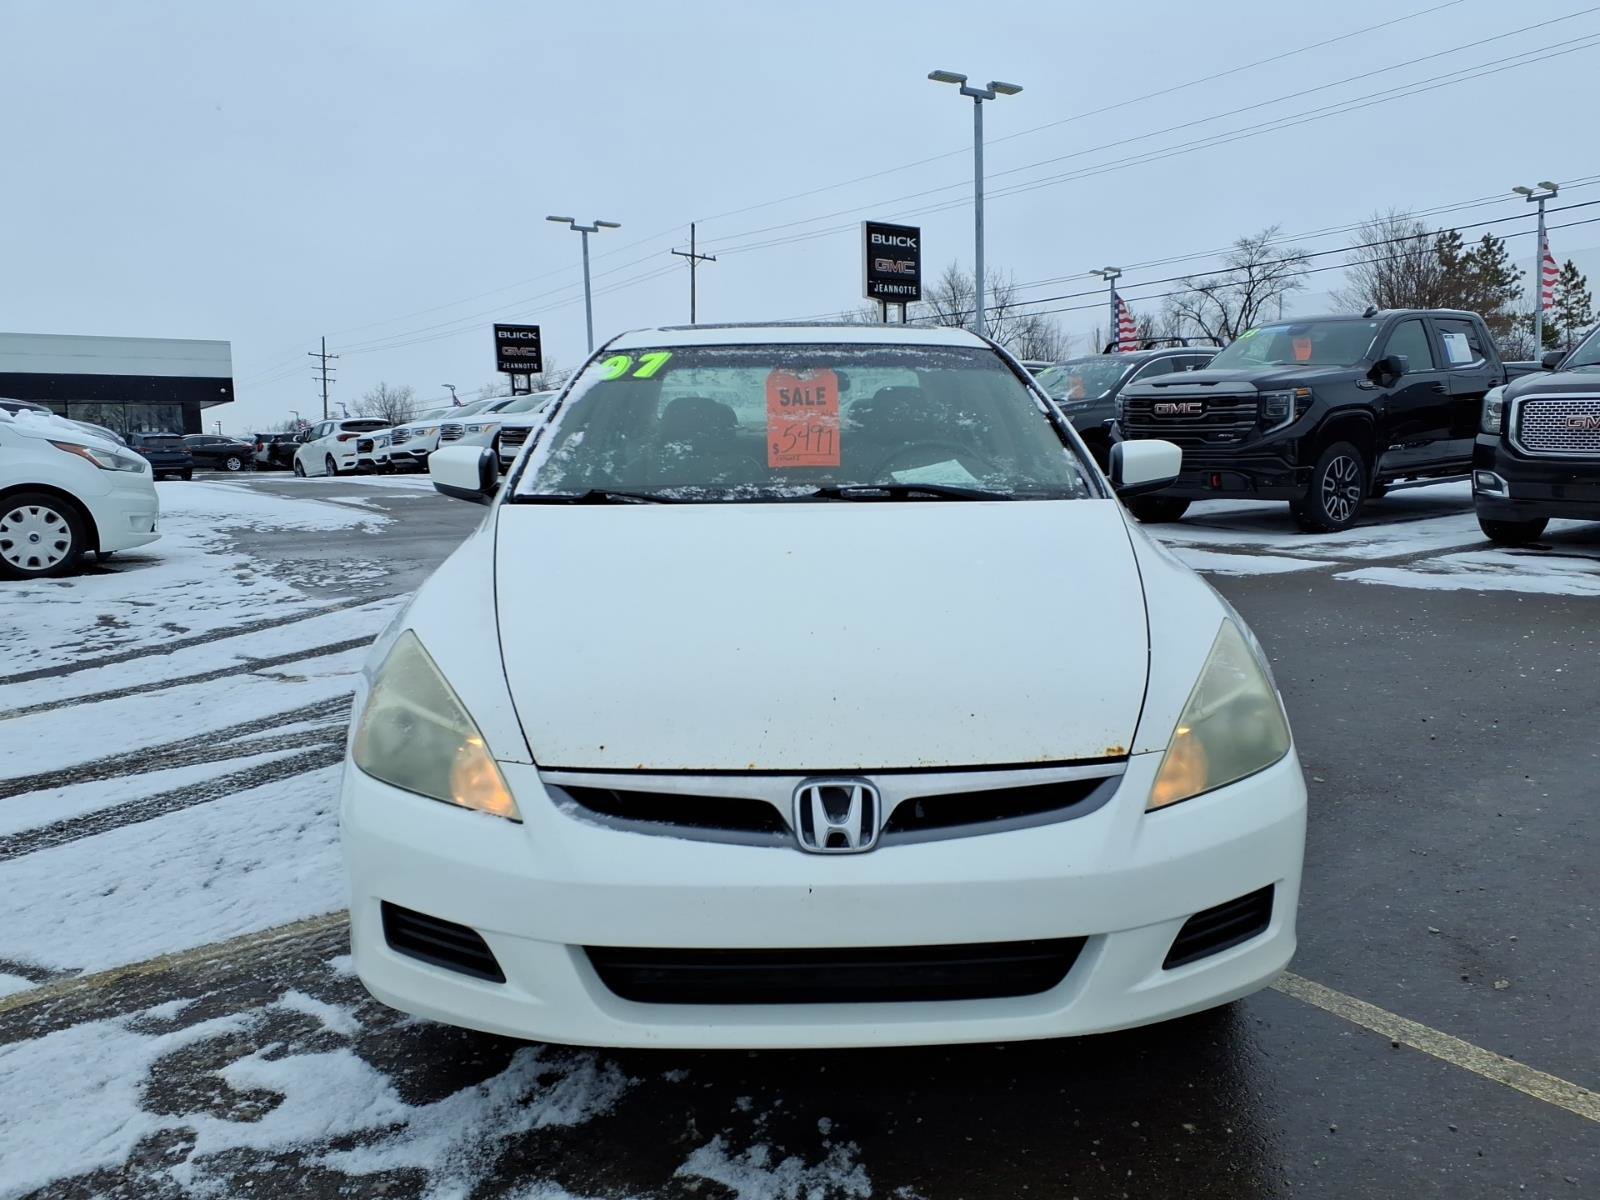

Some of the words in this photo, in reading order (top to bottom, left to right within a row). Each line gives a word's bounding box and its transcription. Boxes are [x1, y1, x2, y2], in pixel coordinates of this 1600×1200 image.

[871, 233, 917, 248] BUICK
[875, 258, 915, 274] GMC
[874, 284, 917, 295] JEANNOTTE
[498, 331, 537, 339] BUICK
[502, 346, 536, 356] GMC
[502, 362, 537, 370] JEANNOTTE
[779, 386, 826, 407] SALE
[1154, 402, 1202, 414] GMC
